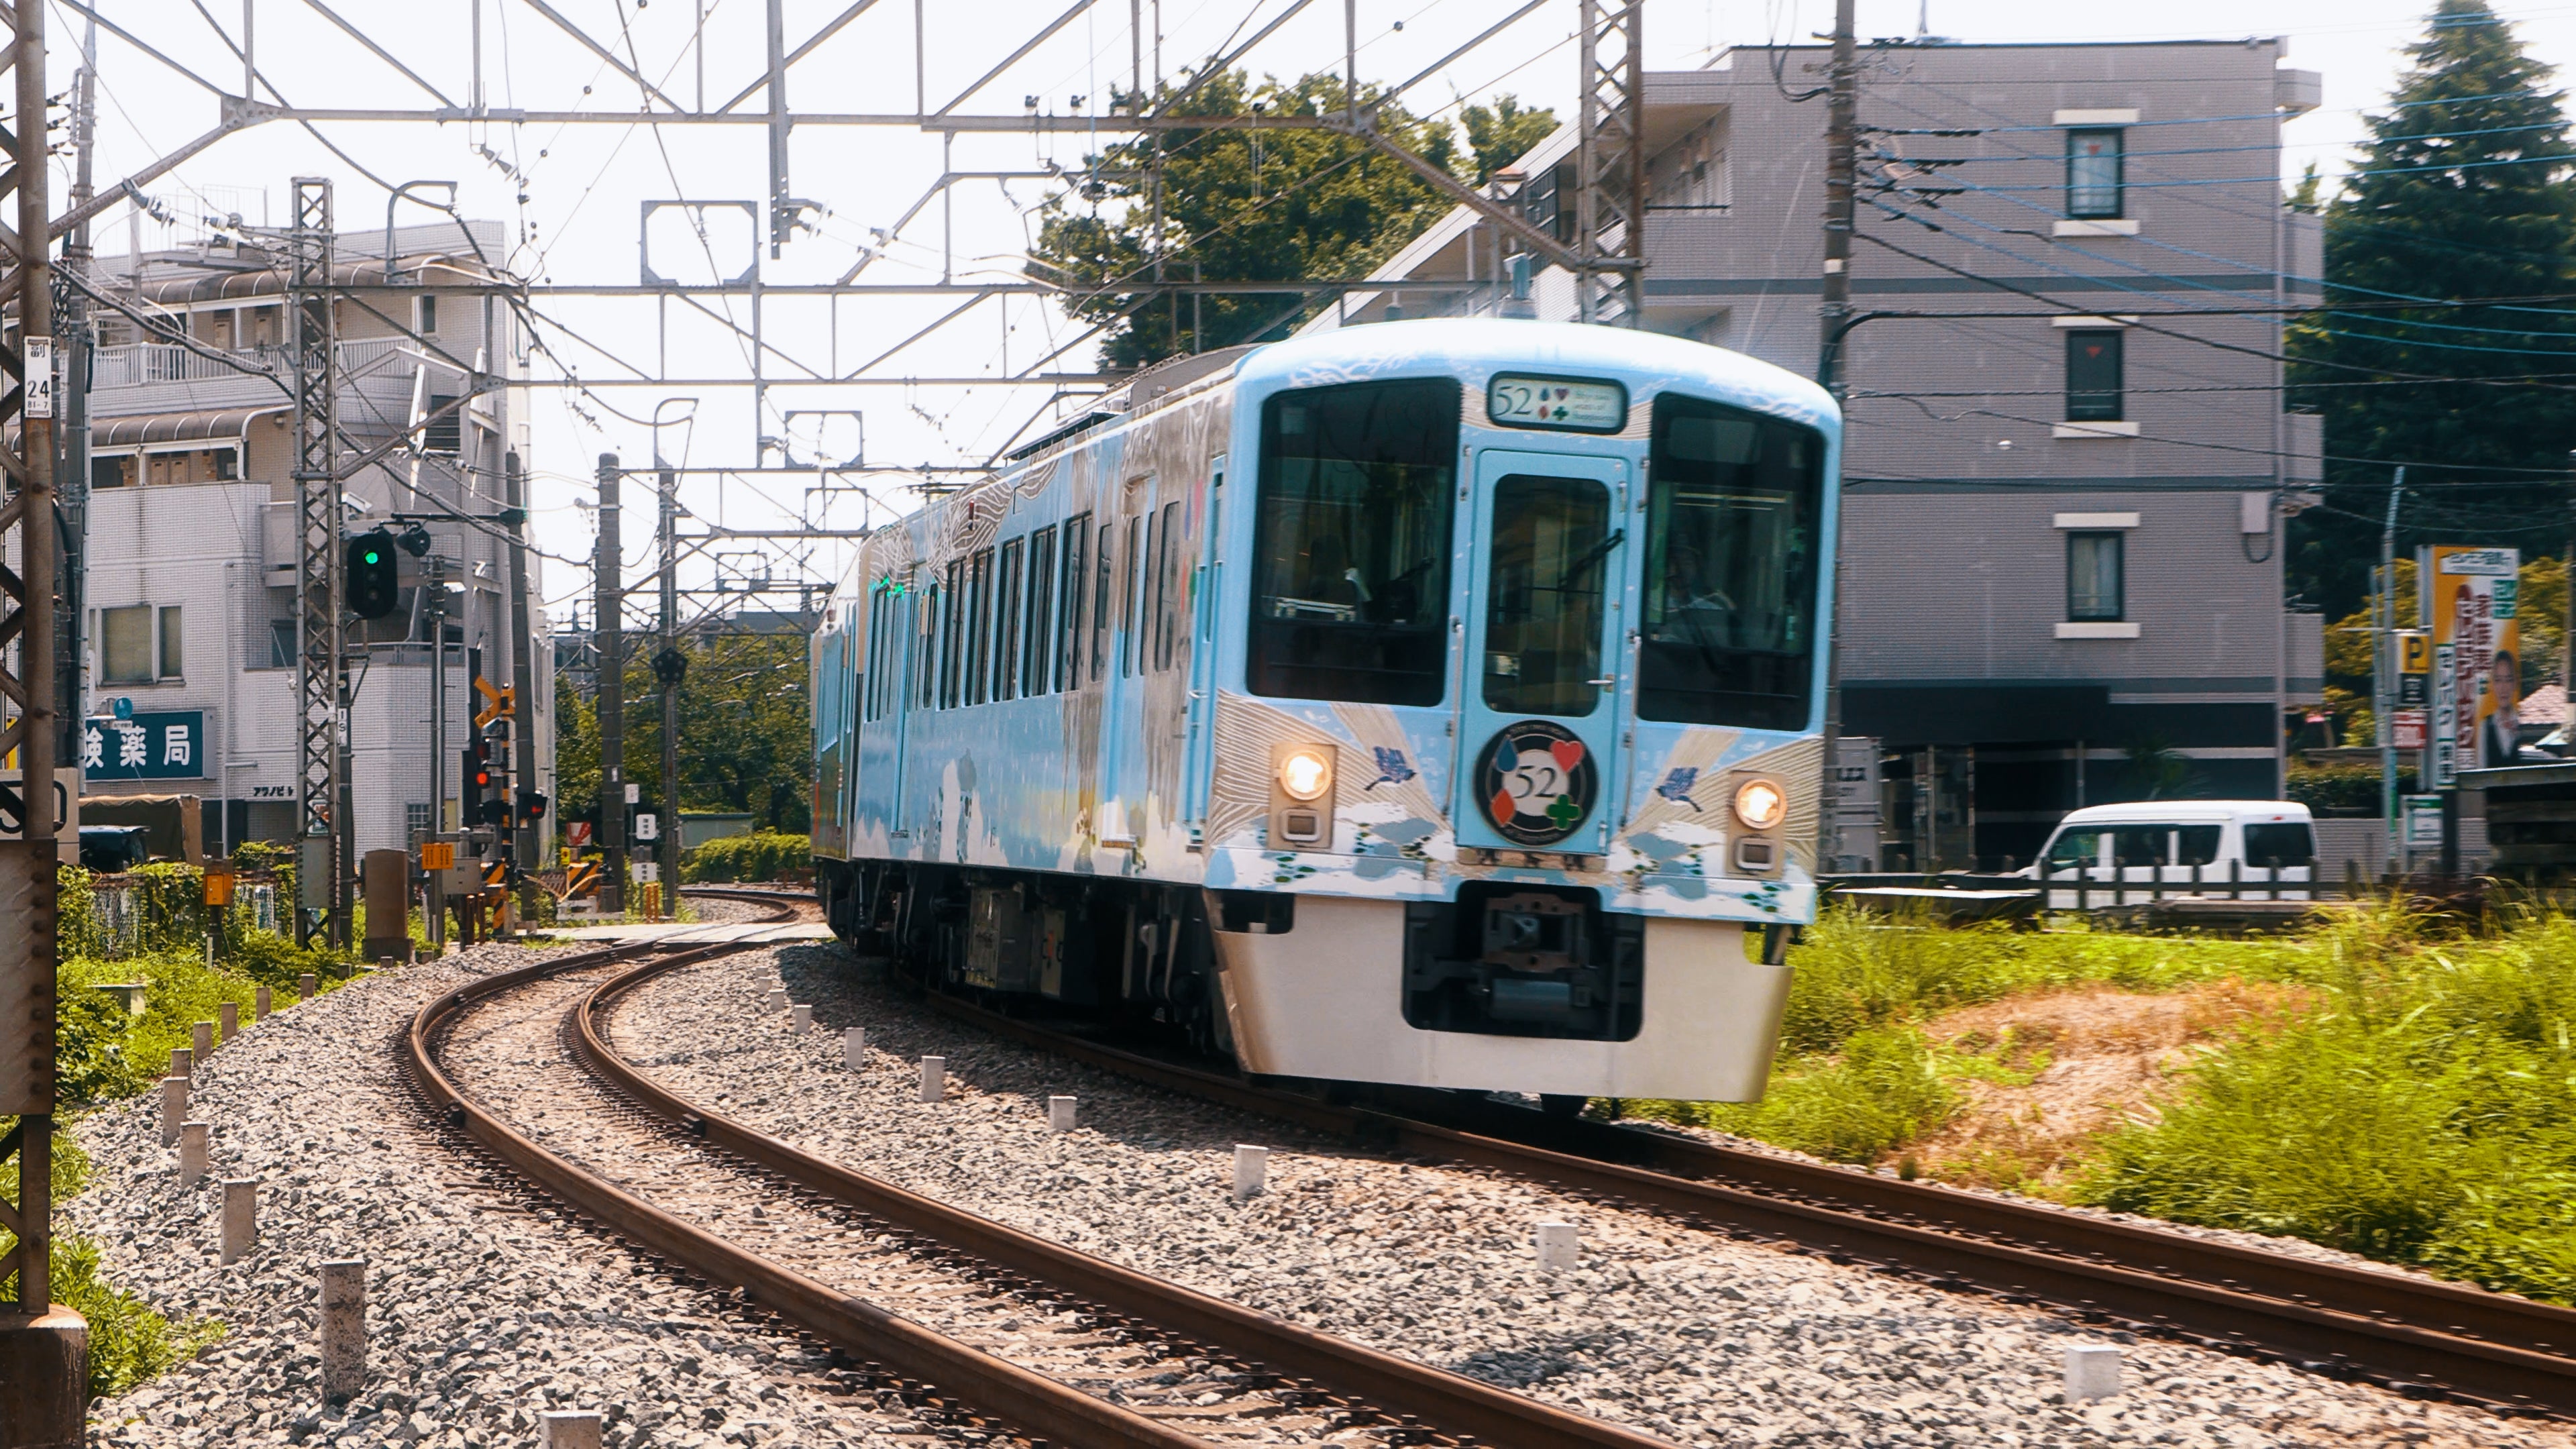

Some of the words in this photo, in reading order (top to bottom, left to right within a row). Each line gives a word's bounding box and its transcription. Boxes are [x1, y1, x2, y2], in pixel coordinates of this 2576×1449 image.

[28, 380, 50, 398] 24
[1494, 386, 1532, 417] 52
[2408, 637, 2424, 669] P
[1513, 765, 1558, 799] 52
